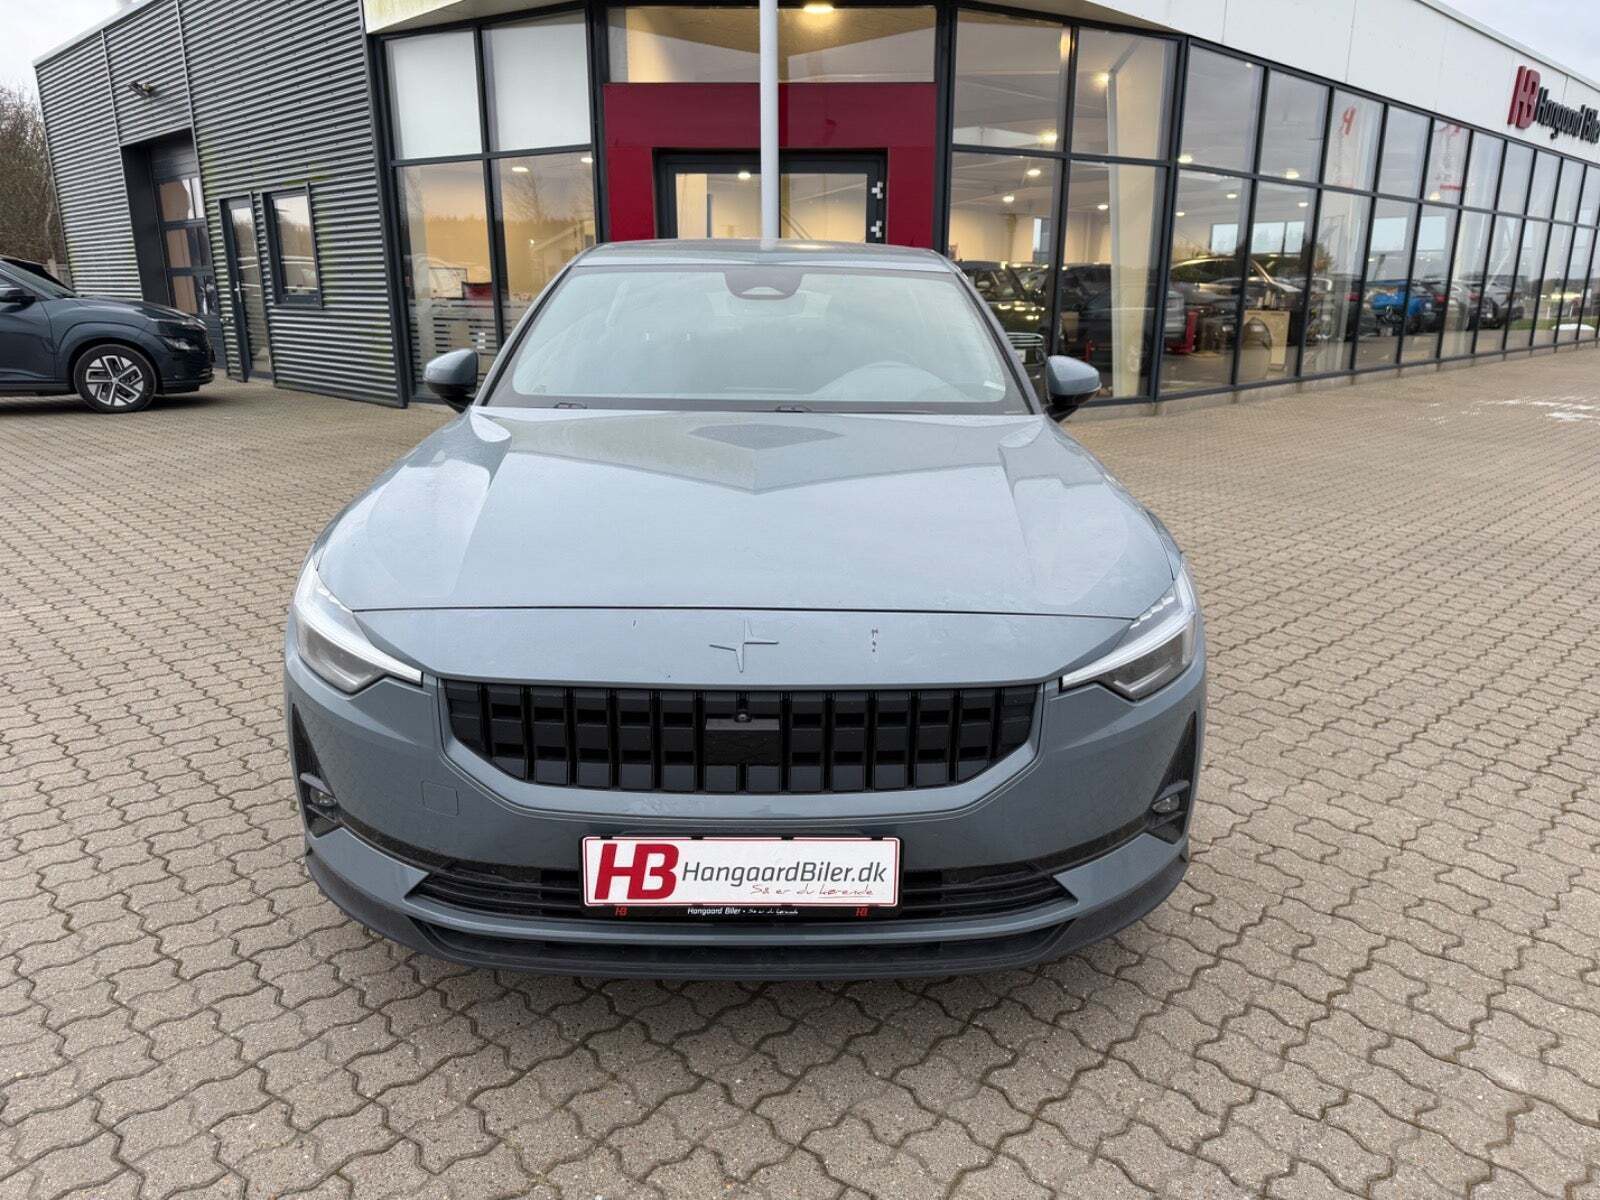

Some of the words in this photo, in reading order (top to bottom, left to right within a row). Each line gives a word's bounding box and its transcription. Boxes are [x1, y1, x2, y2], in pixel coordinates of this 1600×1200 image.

[1533, 86, 1586, 139] Hangaard
[594, 843, 680, 900] HB
[682, 861, 887, 887] HangaardBiler.dk
